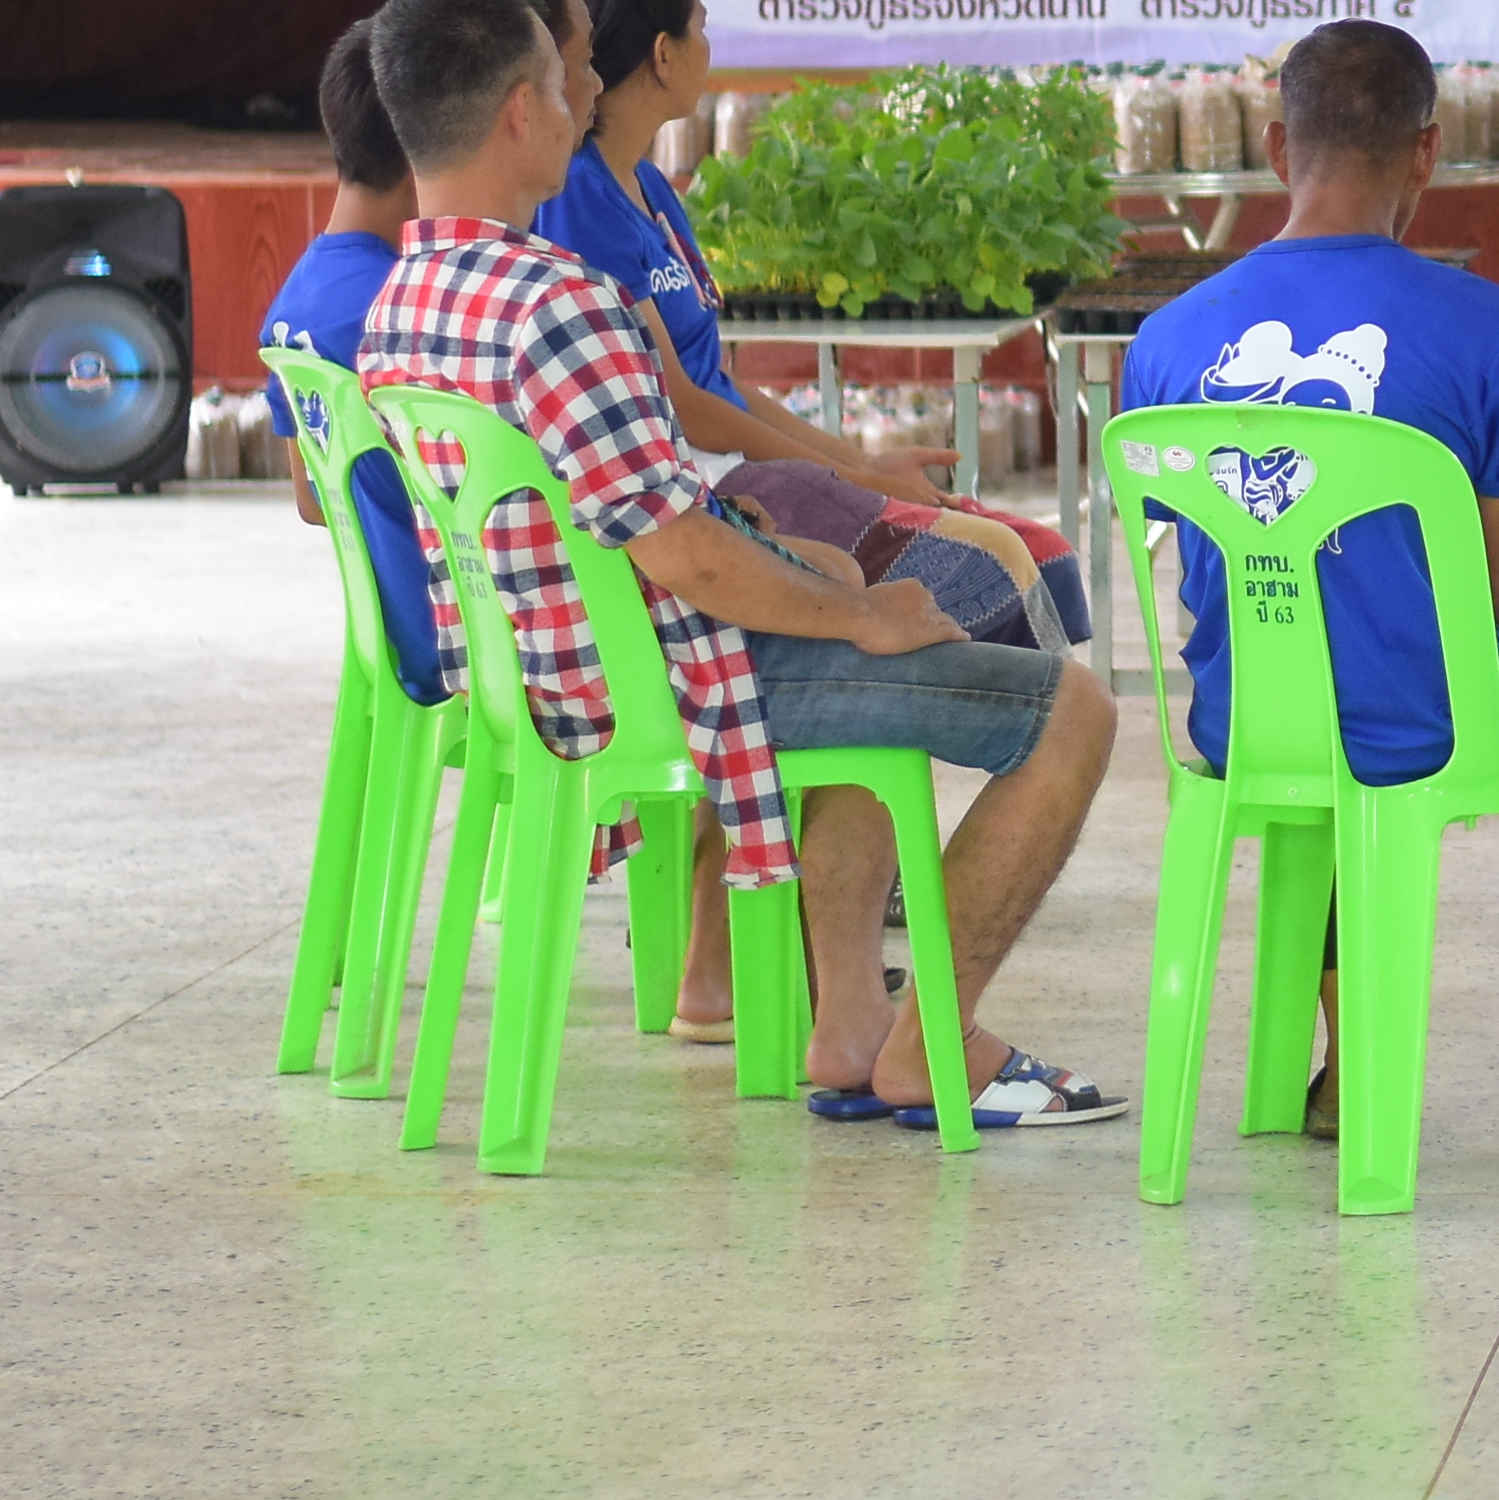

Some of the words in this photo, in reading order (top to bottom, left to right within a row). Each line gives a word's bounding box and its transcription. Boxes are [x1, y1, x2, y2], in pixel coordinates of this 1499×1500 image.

[1245, 553, 1295, 573] กทบ.
[1245, 579, 1299, 598] อาฮาม
[1255, 601, 1269, 623] ปี
[1275, 605, 1295, 624] 63
